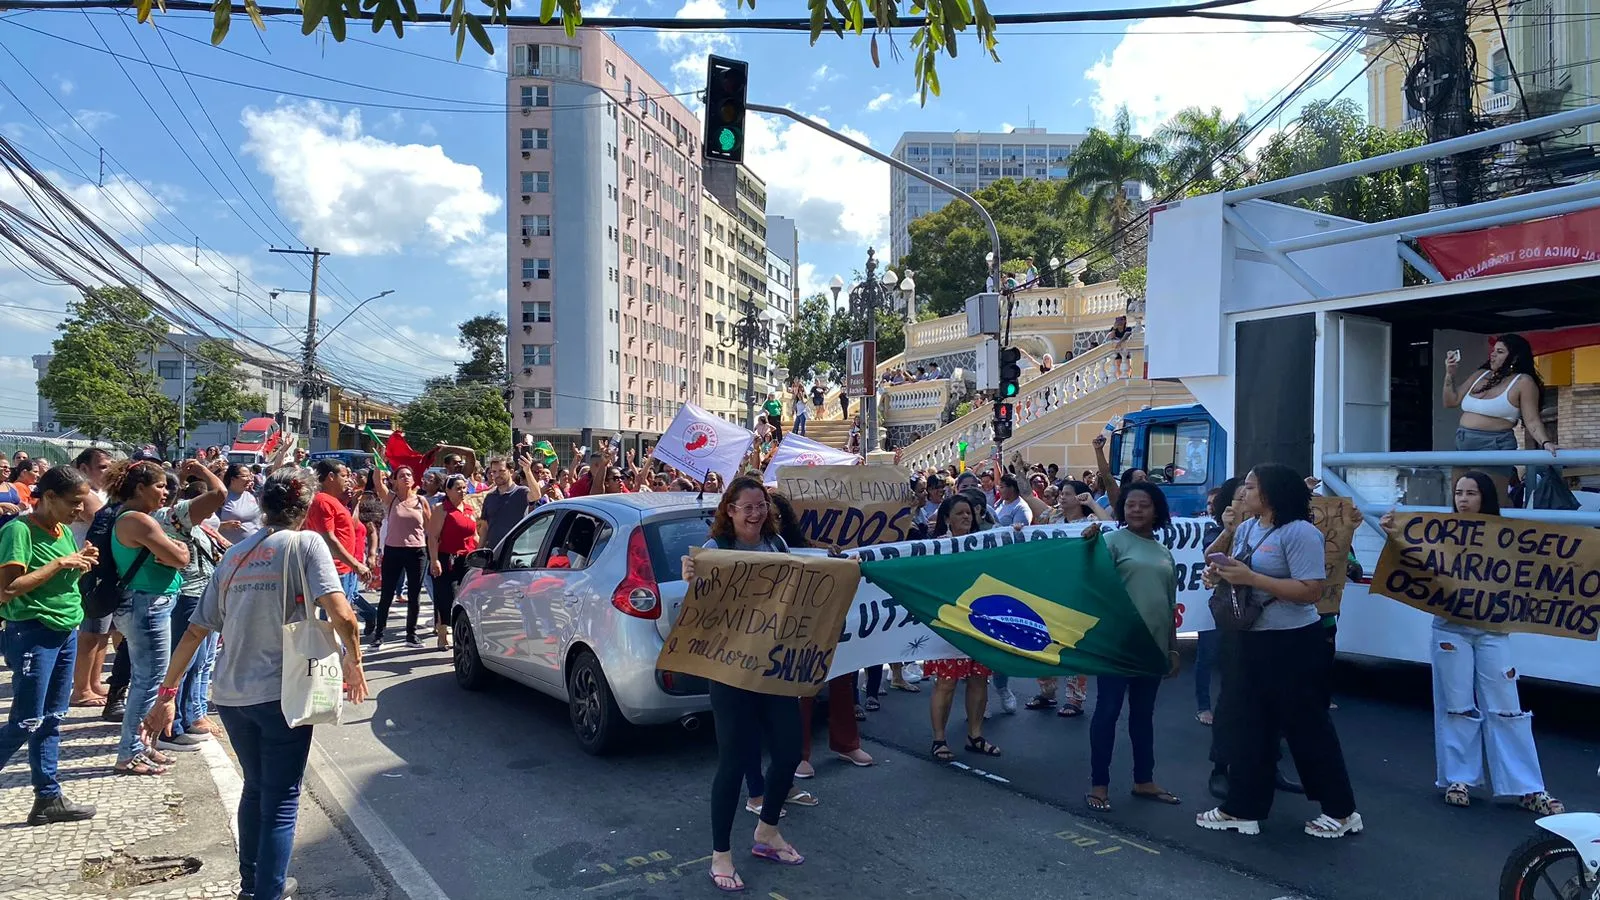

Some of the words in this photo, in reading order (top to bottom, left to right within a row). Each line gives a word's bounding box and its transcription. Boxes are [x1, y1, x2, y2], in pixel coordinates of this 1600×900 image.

[800, 506, 912, 547] NIDOS
[1403, 516, 1486, 547] CORTE
[1497, 527, 1515, 548] O
[1517, 529, 1583, 559] SEU
[694, 566, 722, 600] POR
[1399, 547, 1512, 584] SALÁRIO
[1514, 560, 1535, 588] E
[1534, 561, 1600, 598] NÃO
[1385, 570, 1433, 600] OS
[1426, 587, 1511, 623] MEUS
[306, 657, 339, 678] Pro
[688, 633, 767, 672] melhores
